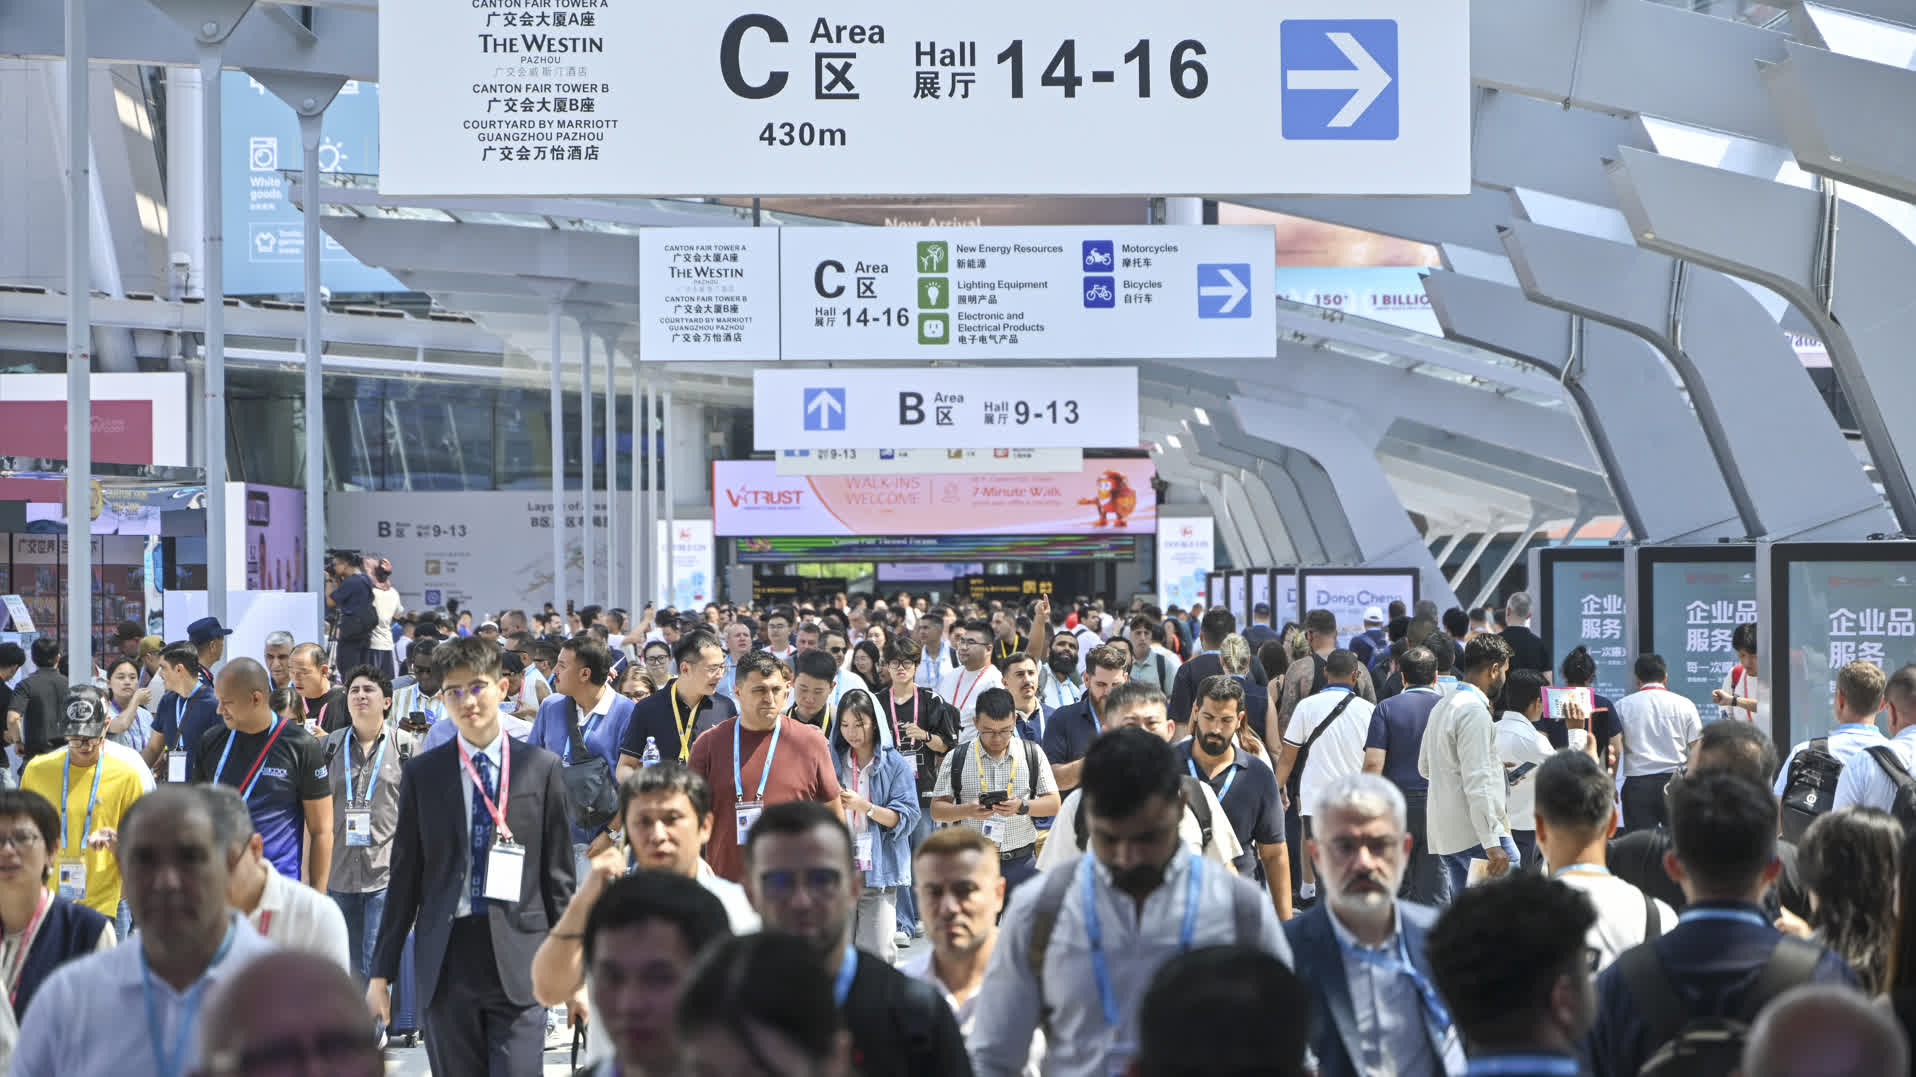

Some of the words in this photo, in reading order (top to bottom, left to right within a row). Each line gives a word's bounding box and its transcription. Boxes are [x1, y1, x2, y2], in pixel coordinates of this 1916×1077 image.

[472, 0, 520, 8] CANTON
[524, 0, 551, 8] FAIR
[555, 0, 597, 8] TOWER
[600, 0, 608, 8] A
[486, 12, 596, 27] 广交会大厦A座
[478, 34, 519, 53] THE
[521, 34, 603, 53] WESTIN
[520, 56, 561, 64] PAZHOU
[719, 13, 789, 99] C
[810, 17, 885, 44] Area
[914, 41, 976, 67] Hall
[997, 39, 1209, 99] 14-16
[815, 52, 859, 100] 区
[472, 84, 522, 93] CANTON
[525, 84, 552, 93] FAIR
[555, 84, 598, 93] TOWER
[601, 84, 609, 93] B
[913, 72, 977, 100] 展厅
[487, 98, 596, 113] 广交会大厦B座
[463, 120, 535, 129] COURTYARD
[539, 120, 554, 129] BY
[557, 120, 618, 129] MARRIOTT
[478, 132, 552, 141] GUANGZHOU
[556, 132, 604, 141] PAZHOU
[759, 122, 847, 146] 430m
[482, 145, 599, 161] 广交会万怡酒店
[249, 176, 281, 188] White
[249, 189, 283, 202] goods
[956, 244, 975, 253] New
[978, 244, 1011, 255] Energy
[1014, 244, 1063, 253] Resources
[1122, 243, 1178, 254] Motorcycles
[673, 253, 739, 263] 广交会大厦A座
[956, 258, 987, 269] 新能源
[1122, 257, 1152, 268] 摩托车
[668, 266, 693, 278] THE
[694, 266, 744, 278] WESTIN
[814, 259, 846, 299] C
[855, 261, 889, 274] Area
[957, 279, 995, 290] Lighting
[997, 279, 1048, 290] Equipment
[1123, 279, 1162, 290] Bicycles
[857, 277, 877, 298] 区
[957, 293, 998, 305] 照明产品
[1123, 292, 1153, 304] 自行车
[1383, 295, 1430, 305] BILLIO
[673, 304, 739, 314] 广交会大厦B座
[814, 317, 836, 327] 展厅
[815, 307, 836, 316] Hall
[842, 307, 910, 327] 14-16
[958, 311, 1004, 321] Electronic
[1006, 311, 1024, 321] and
[958, 323, 1001, 332] Electrical
[1002, 322, 1045, 332] Products
[672, 333, 742, 343] 广交会万怡酒店
[958, 334, 1018, 345] 电子电气产品
[899, 391, 925, 425] B
[934, 392, 964, 404] Area
[984, 402, 1009, 412] Hall
[1014, 401, 1080, 425] 9-13
[936, 406, 954, 425] 区
[984, 413, 1009, 424] 展厅
[830, 449, 857, 460] 9-13
[846, 492, 920, 505] WELCOME
[378, 521, 391, 537] B
[432, 525, 467, 537] 9-13
[1316, 590, 1354, 604] Dong
[1581, 594, 1626, 615] 企业
[1686, 600, 1758, 625] 企业品
[1829, 607, 1915, 636] 企业品
[1581, 618, 1622, 639] 服务
[1686, 628, 1733, 652] 服务
